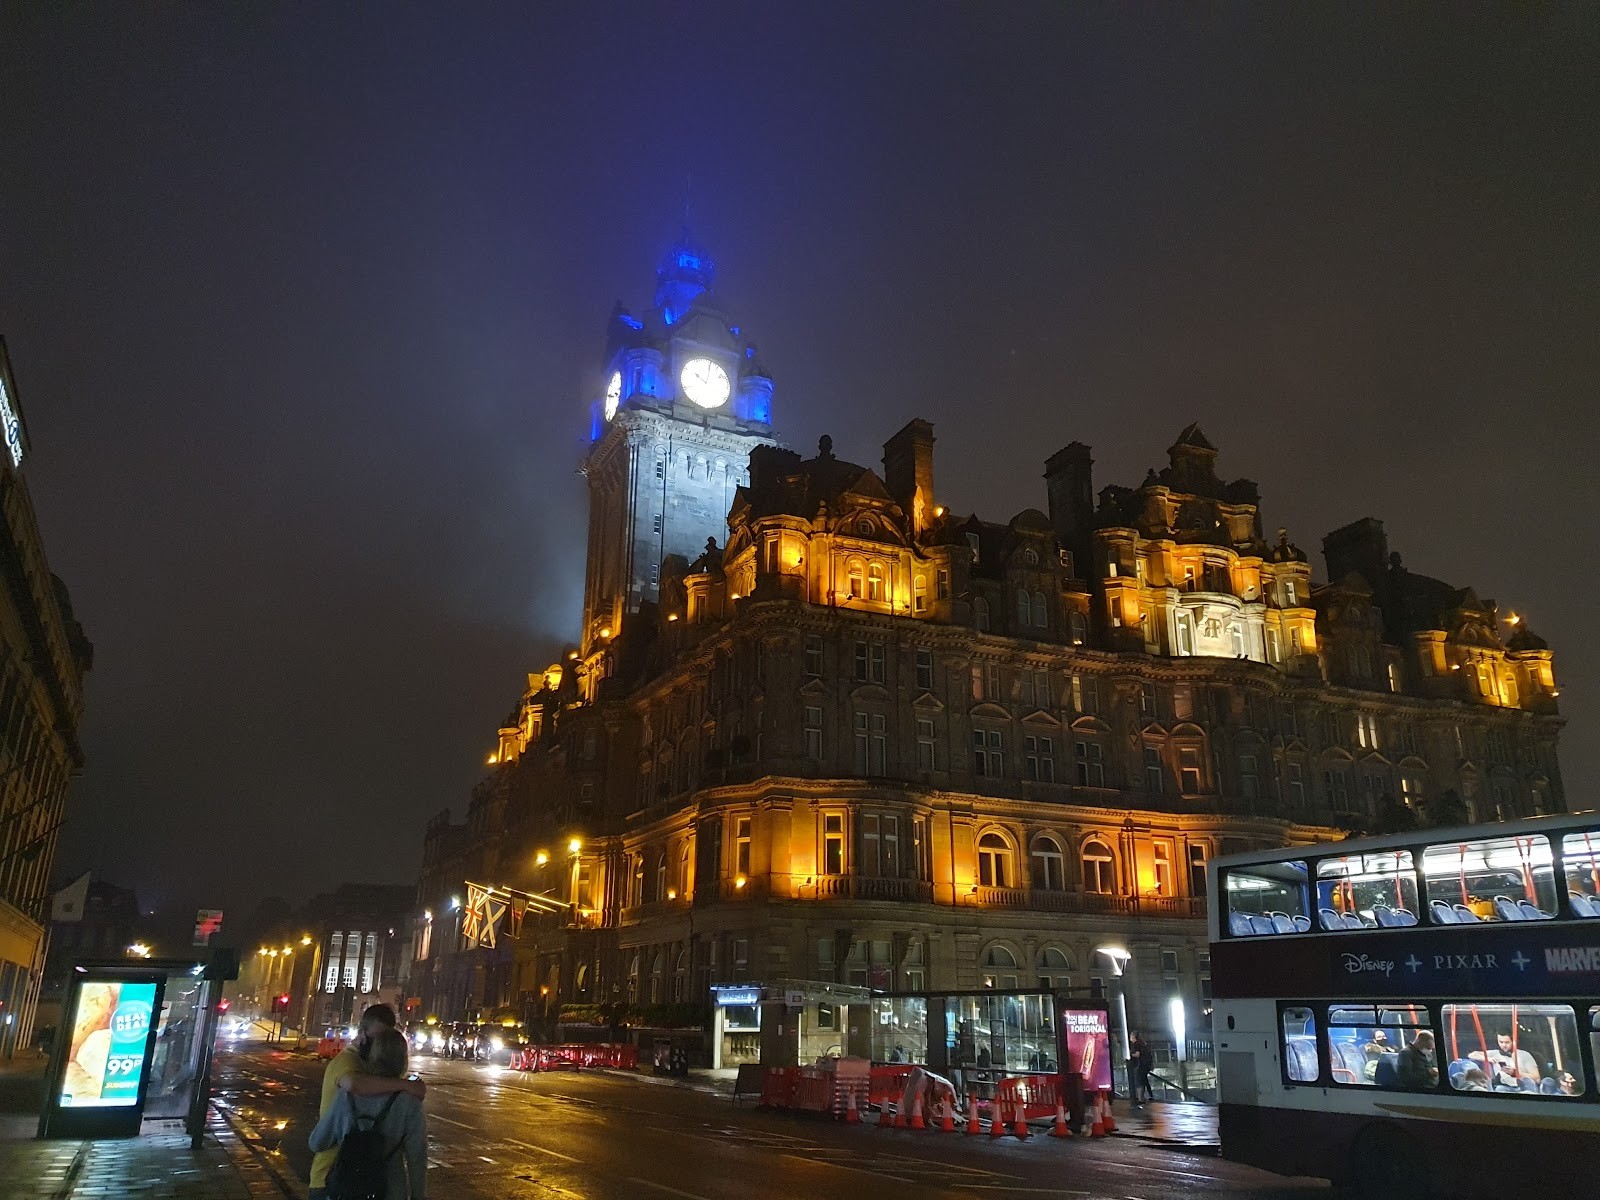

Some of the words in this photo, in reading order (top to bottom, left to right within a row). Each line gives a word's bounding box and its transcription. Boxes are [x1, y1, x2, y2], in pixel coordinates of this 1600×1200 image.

[1341, 953, 1395, 977] Disney
[1433, 954, 1499, 969] PIXAR
[116, 1012, 147, 1023] REAL
[1078, 1015, 1098, 1024] BEAT
[116, 1020, 147, 1031] DEAL
[1074, 1025, 1106, 1033] ORIGINAL
